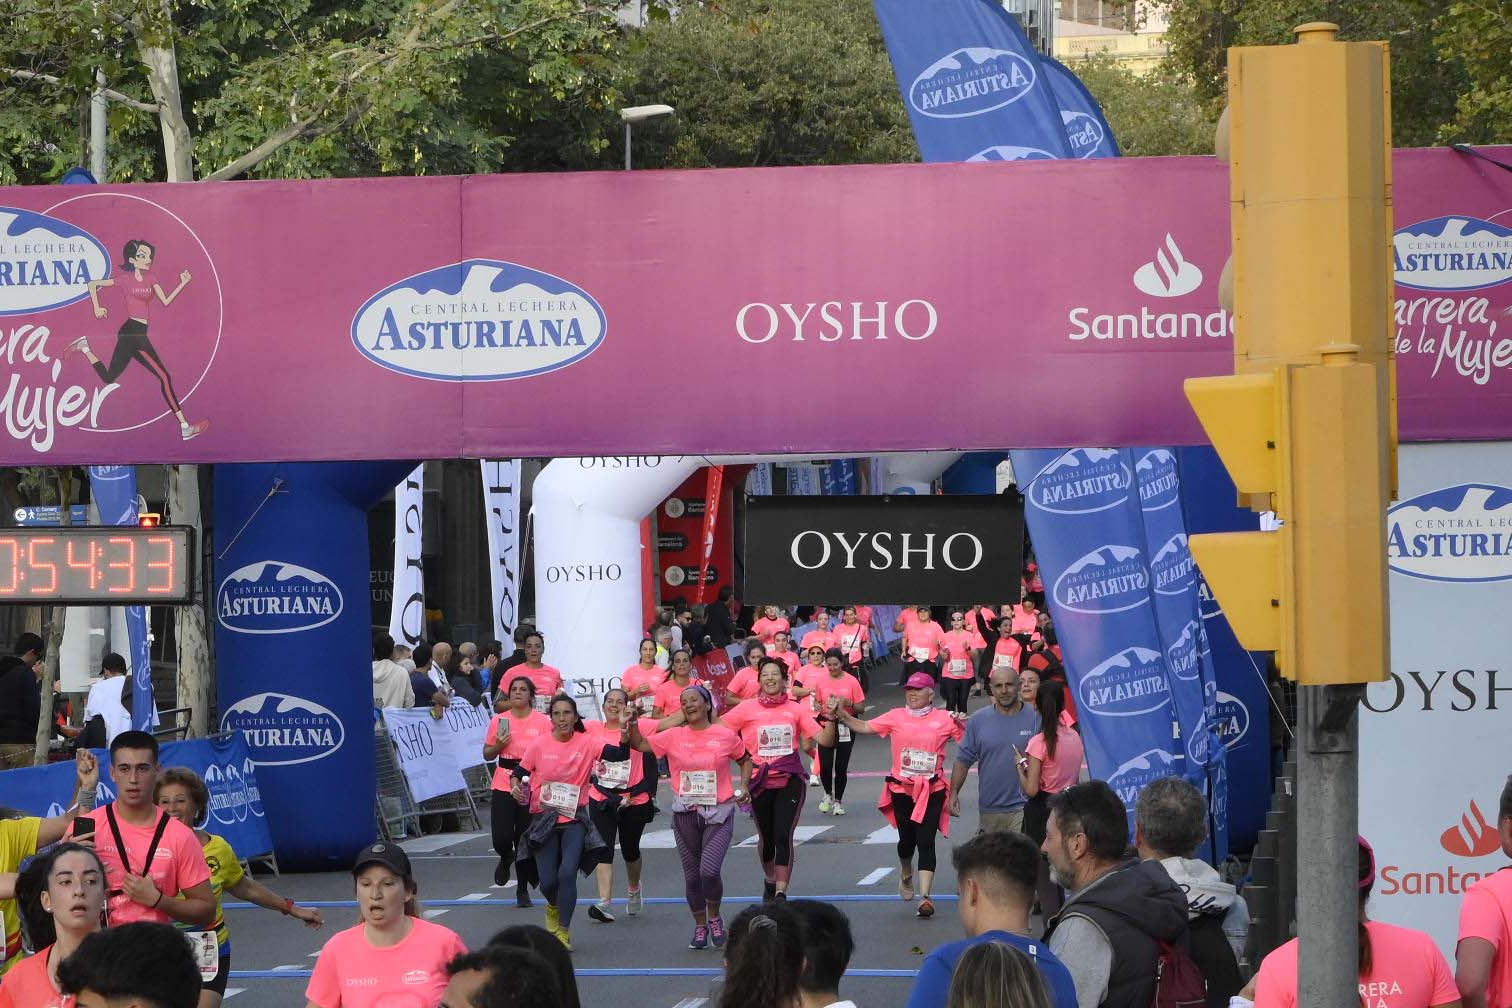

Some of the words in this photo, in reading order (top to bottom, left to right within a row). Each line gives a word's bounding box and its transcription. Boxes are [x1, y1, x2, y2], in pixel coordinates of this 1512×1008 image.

[14, 243, 86, 254] LECHERA
[1408, 241, 1460, 250] CENTRAL
[411, 302, 488, 315] CENTRAL
[498, 300, 577, 312] LECHERA
[1394, 297, 1489, 326] arrera
[372, 306, 587, 351] ASTURIANA
[736, 299, 938, 344] OYSHO
[1069, 308, 1233, 340] Santand
[1418, 327, 1435, 354] la
[1431, 320, 1512, 385] Muje
[1415, 519, 1482, 529] CENTRAL
[791, 530, 984, 572] OYSHO
[1387, 522, 1512, 558] ASTURI
[546, 563, 622, 584] OYSHO
[233, 586, 275, 595] CENTRAL
[278, 585, 330, 594] LECHERA
[221, 593, 334, 618] ASTURIANA
[235, 718, 276, 727] CENTRAL
[279, 717, 330, 726] LECHERA
